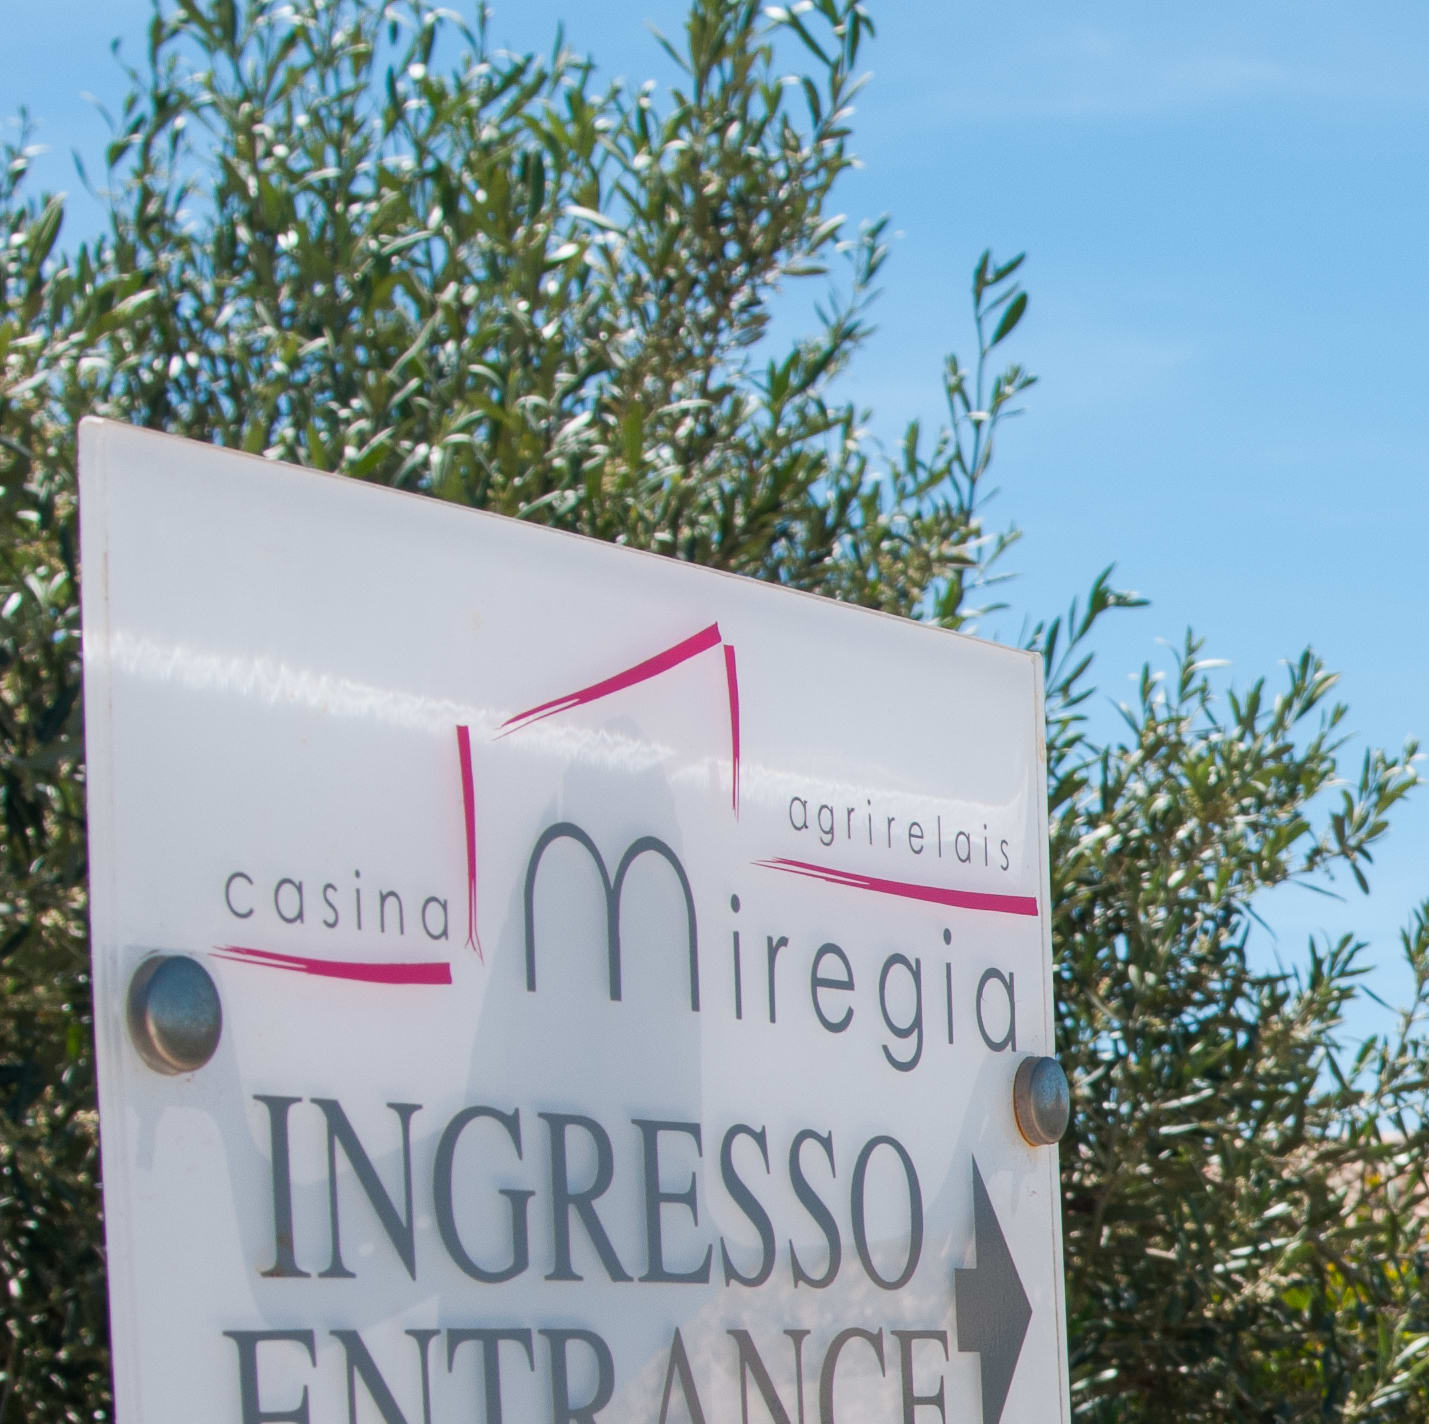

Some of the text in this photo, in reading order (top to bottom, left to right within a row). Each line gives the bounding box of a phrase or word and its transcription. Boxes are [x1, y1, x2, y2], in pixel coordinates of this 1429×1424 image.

[787, 794, 1013, 873] agrirelais
[223, 869, 452, 942] casina
[252, 1093, 924, 1291] INGRESSO
